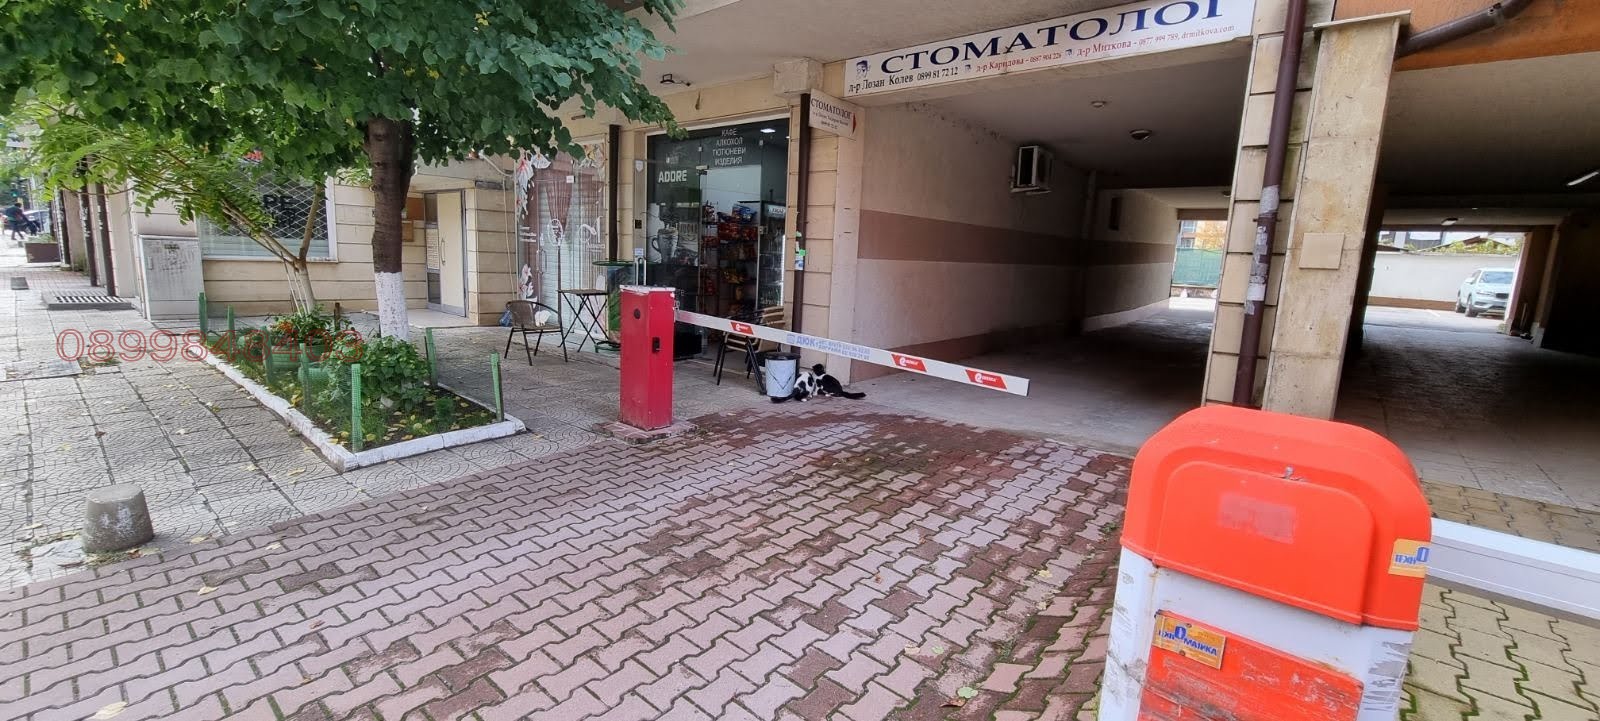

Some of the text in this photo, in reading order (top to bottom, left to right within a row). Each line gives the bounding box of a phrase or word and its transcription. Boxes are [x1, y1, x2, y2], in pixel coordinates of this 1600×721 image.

[881, 0, 1223, 74] СТОМАТОЛОГ
[862, 79, 886, 91] Лозан
[888, 74, 914, 86] Колев
[917, 71, 932, 81] 0899
[932, 69, 940, 79] 81
[941, 68, 950, 77] 72
[950, 66, 959, 76] 12
[1092, 40, 1132, 54] Миткова
[811, 98, 852, 120] СТОМАТОЛОГ
[721, 127, 737, 137] КАФЕ
[716, 136, 743, 147] АЛКОХОЛ
[712, 147, 746, 157] ТЮТЮНЕВИ
[714, 156, 743, 166] ИЗДЕЛИЯ
[658, 170, 688, 183] ADORE
